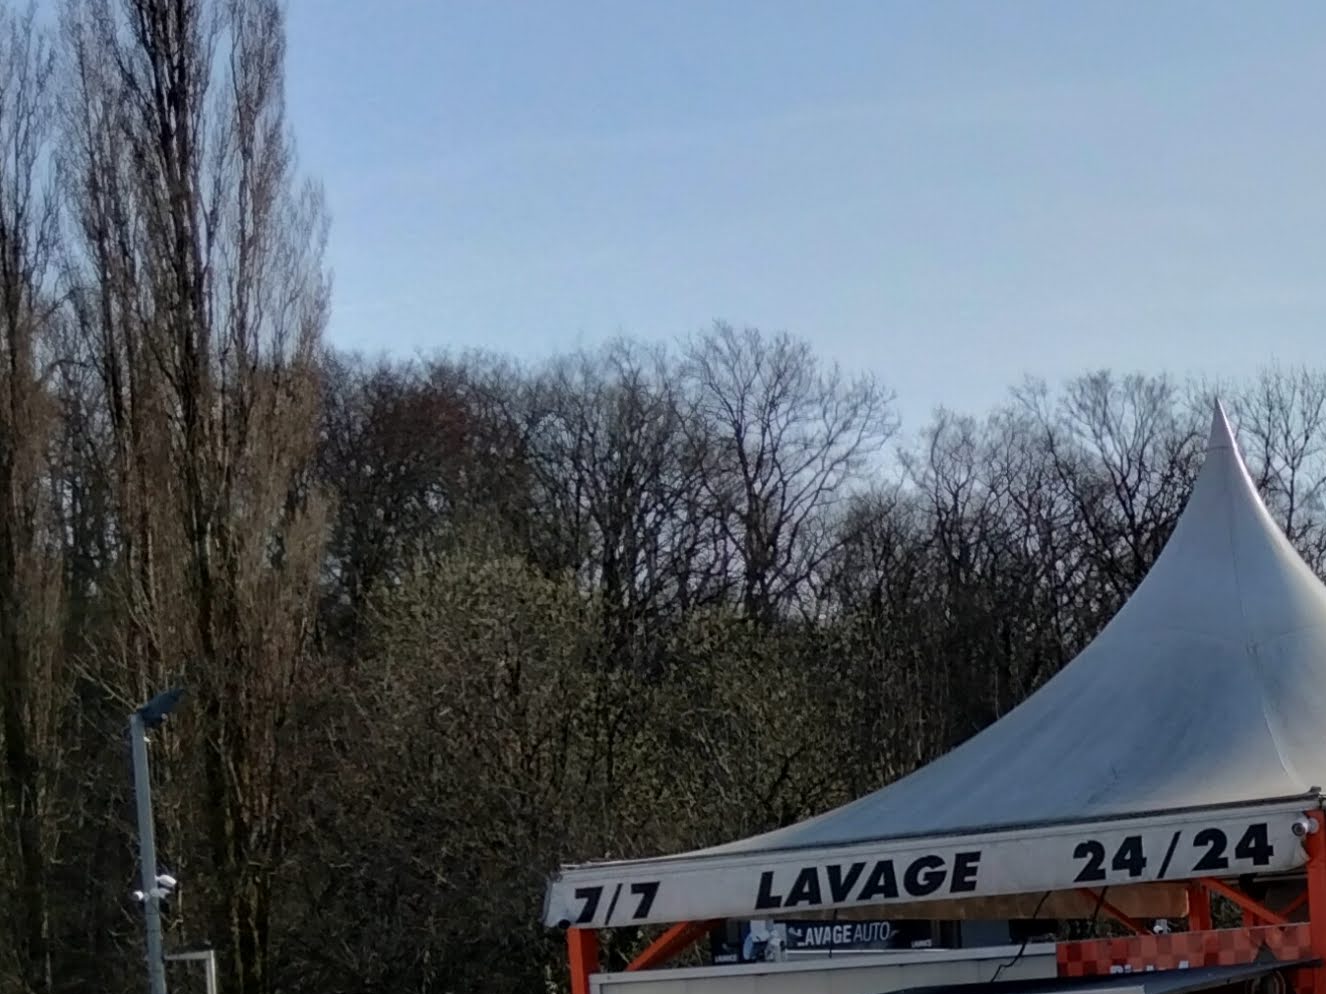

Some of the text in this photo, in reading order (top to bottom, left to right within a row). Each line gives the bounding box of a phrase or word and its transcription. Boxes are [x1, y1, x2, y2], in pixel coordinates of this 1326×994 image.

[575, 823, 1274, 925] 7/7 LAVAGE 24/24
[853, 921, 891, 942] AUTO
